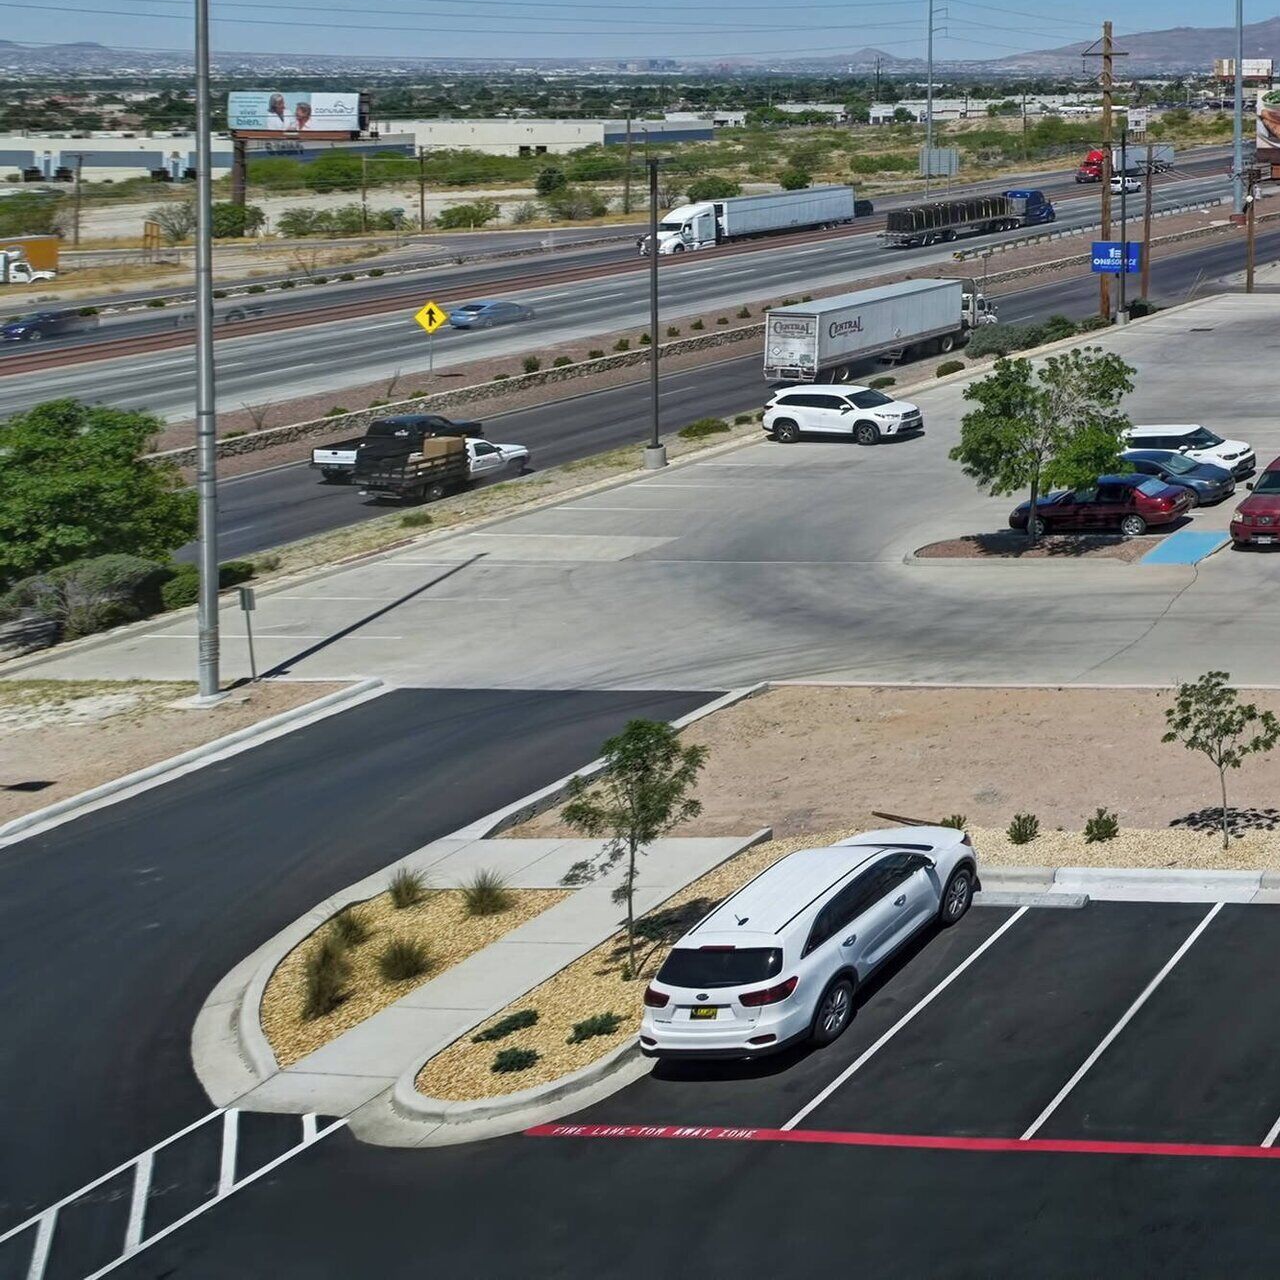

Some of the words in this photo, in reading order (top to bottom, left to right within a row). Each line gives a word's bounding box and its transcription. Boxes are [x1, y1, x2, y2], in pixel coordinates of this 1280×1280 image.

[773, 321, 813, 335] CENTRAL
[829, 315, 864, 339] CENTRAL
[552, 1127, 587, 1135] FIRE
[673, 1128, 713, 1137] AWAY
[718, 1129, 757, 1138] ZONE
